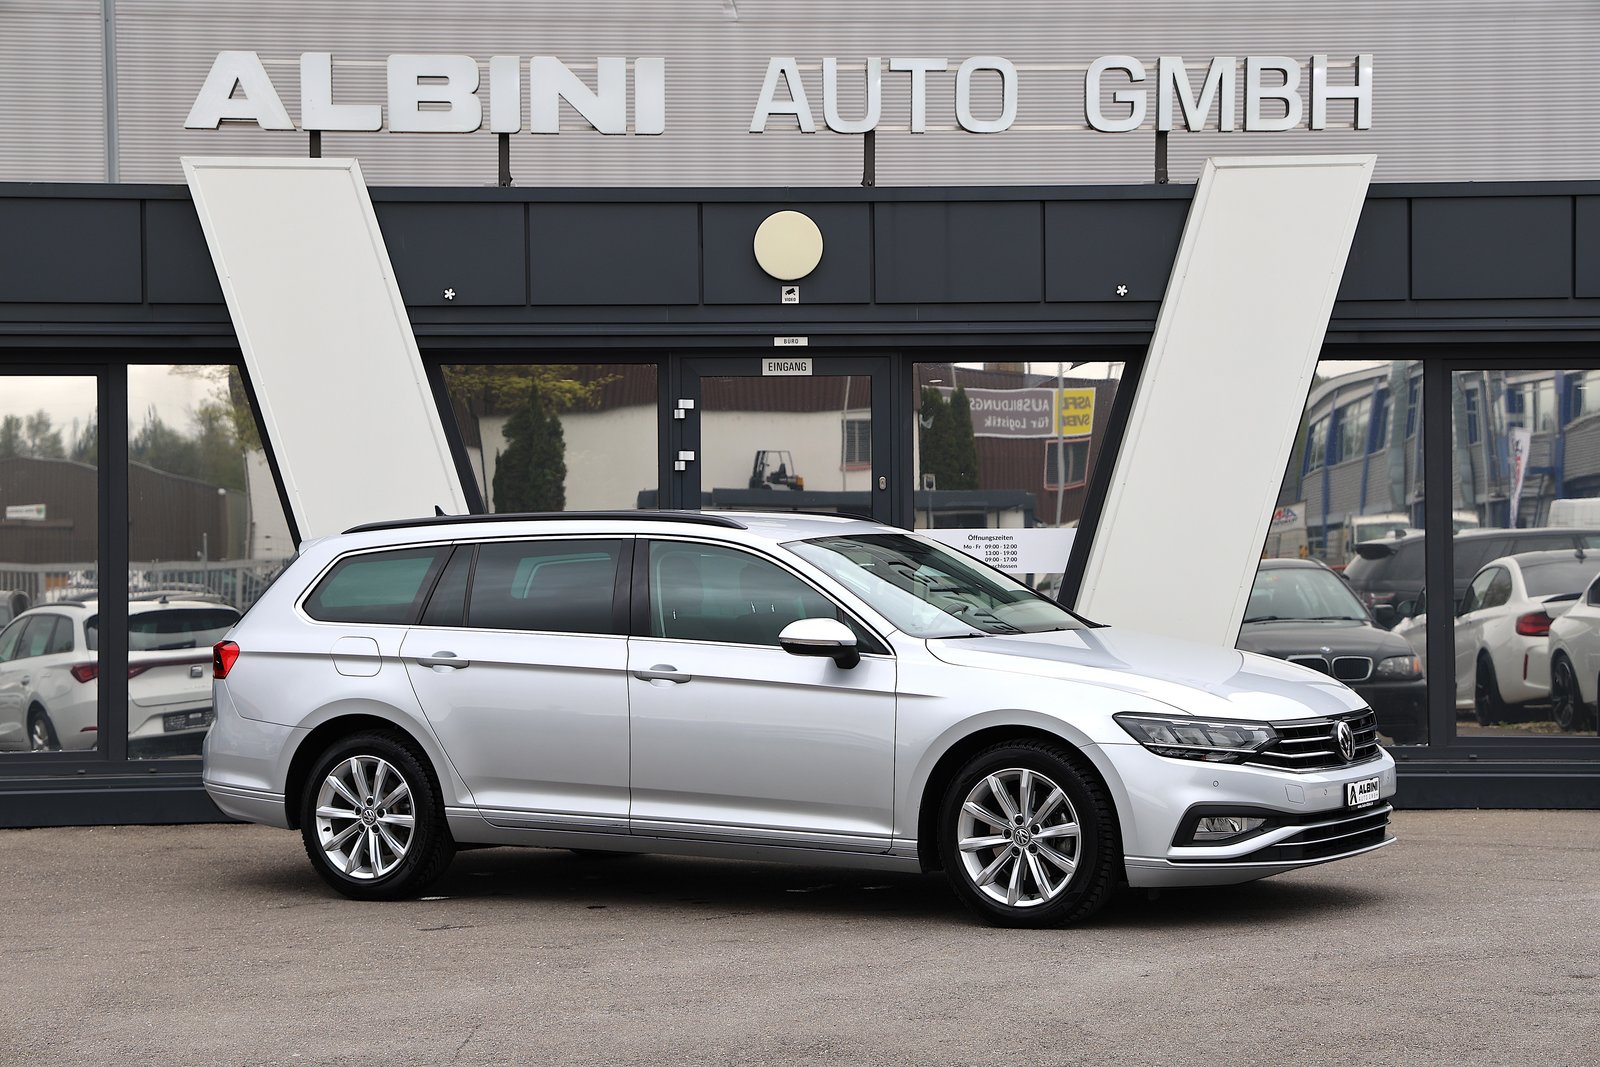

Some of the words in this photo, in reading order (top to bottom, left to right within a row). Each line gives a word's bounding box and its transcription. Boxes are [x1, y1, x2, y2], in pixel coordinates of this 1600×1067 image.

[184, 51, 665, 135] ALBINI
[748, 55, 1019, 134] AUTO
[1084, 53, 1373, 133] GMBH
[768, 362, 807, 372] EINGANG
